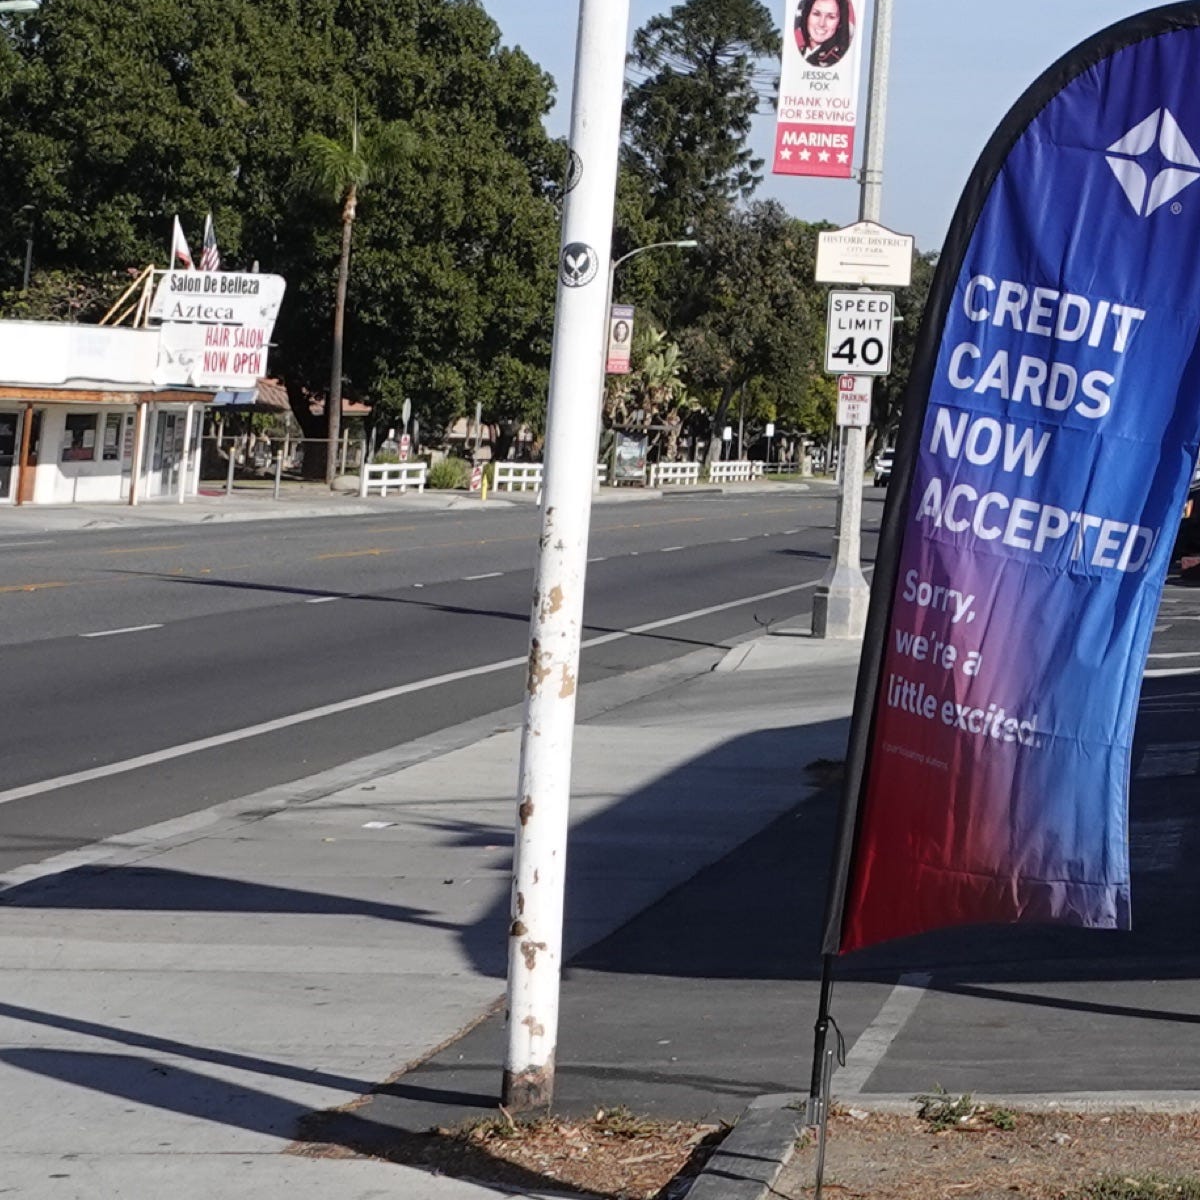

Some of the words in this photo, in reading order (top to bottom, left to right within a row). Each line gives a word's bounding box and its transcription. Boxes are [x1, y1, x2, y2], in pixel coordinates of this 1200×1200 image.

[801, 70, 840, 81] JESSICA
[809, 81, 830, 91] FOX
[783, 95, 822, 107] THANK
[826, 97, 850, 109] YOU
[780, 108, 802, 119] FOR
[805, 109, 855, 122] SERVING
[781, 130, 849, 149] MARINES
[170, 273, 201, 293] Salon
[203, 274, 218, 293] De
[220, 275, 260, 295] Belleza
[170, 301, 234, 320] Azteca
[834, 299, 889, 313] SPEED
[963, 273, 1147, 355] CREDIT
[838, 317, 883, 331] LIMIT
[205, 327, 230, 347] HAIR
[233, 328, 264, 350] SALON
[831, 336, 884, 366] 40
[203, 351, 229, 373] NOW
[233, 352, 262, 375] OPEN
[947, 341, 1116, 420] CARDS
[929, 406, 1051, 478] NOW
[902, 567, 977, 625] Sorry,
[895, 627, 958, 670] we're
[962, 650, 983, 677] a
[887, 672, 936, 720] little
[940, 702, 1042, 749] excited.
